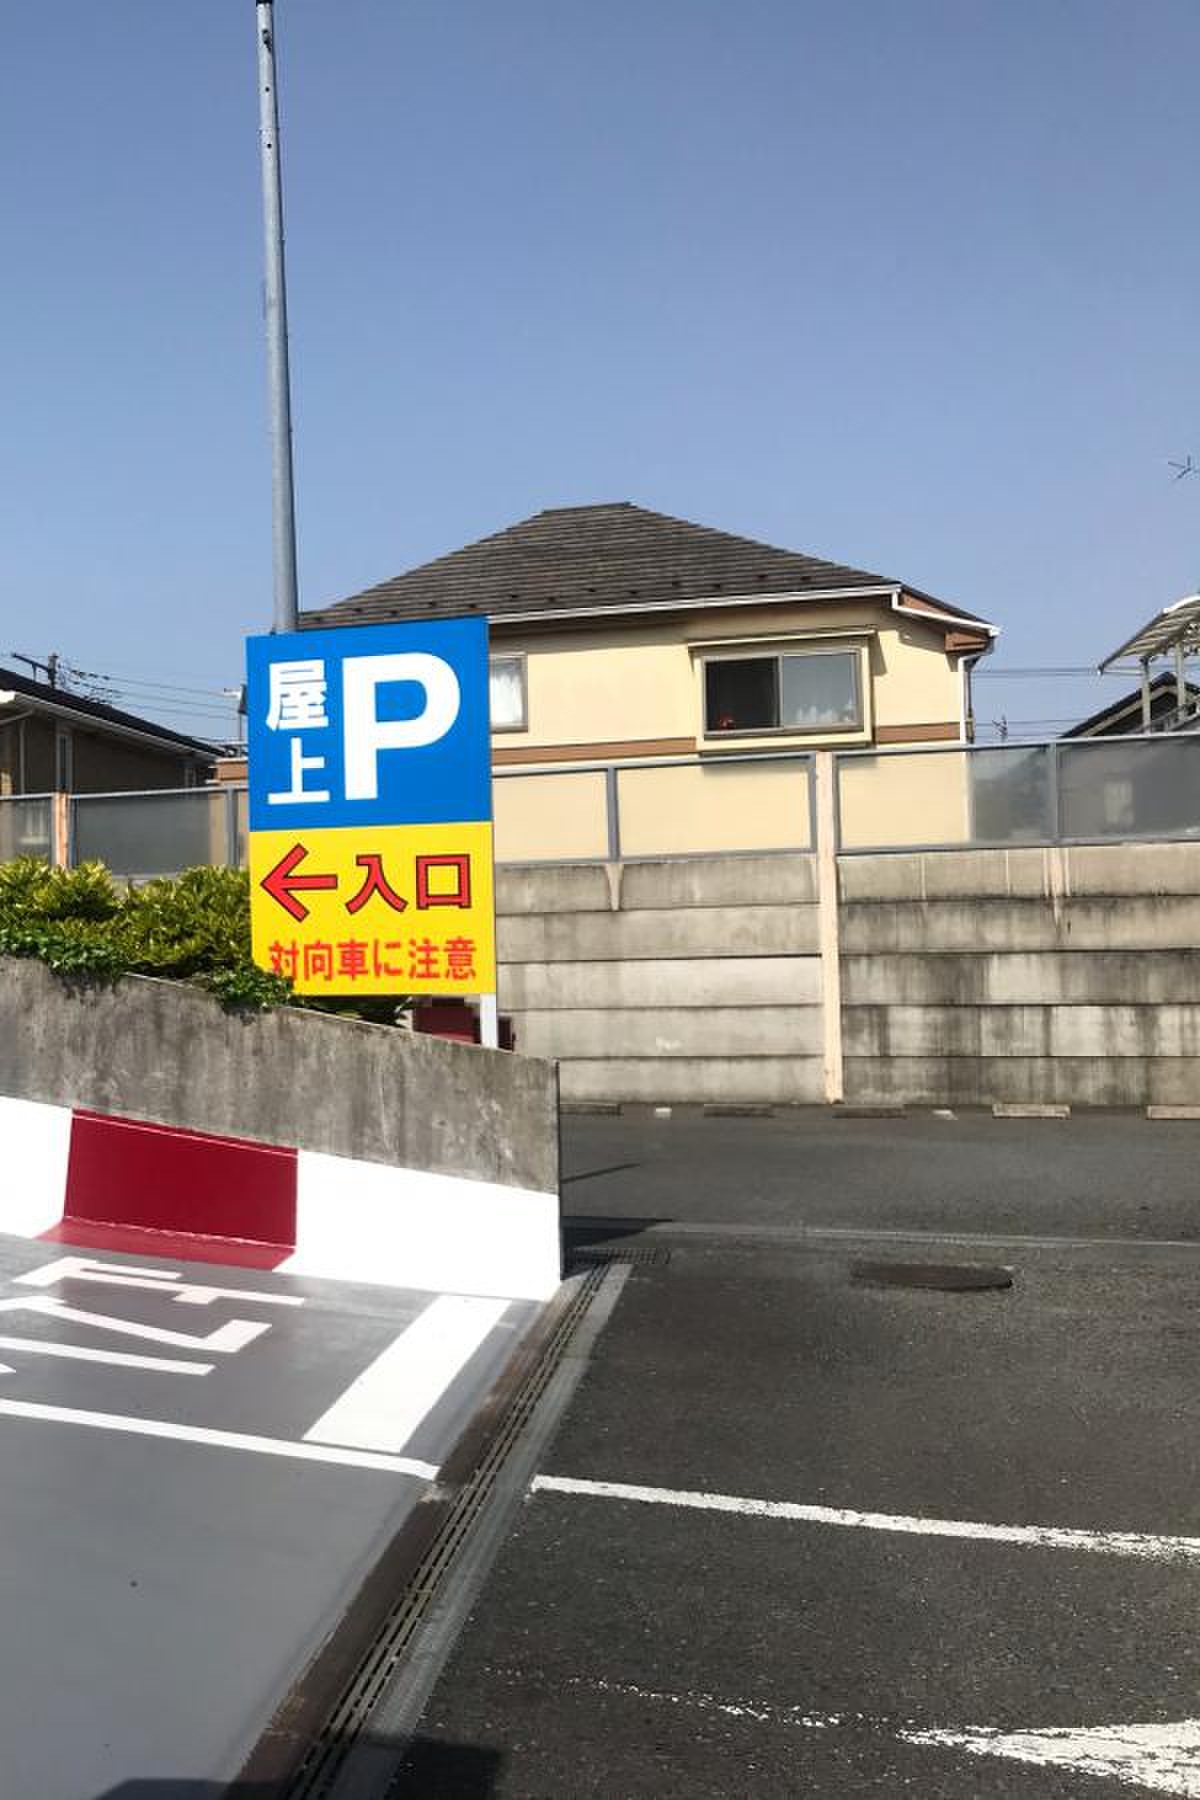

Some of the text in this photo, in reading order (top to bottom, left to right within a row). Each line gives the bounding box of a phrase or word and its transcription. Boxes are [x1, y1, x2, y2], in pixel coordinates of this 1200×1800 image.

[266, 659, 331, 804] 屋上
[342, 652, 461, 801] P
[345, 854, 472, 915] 入口
[269, 938, 477, 981] 対向車に注意
